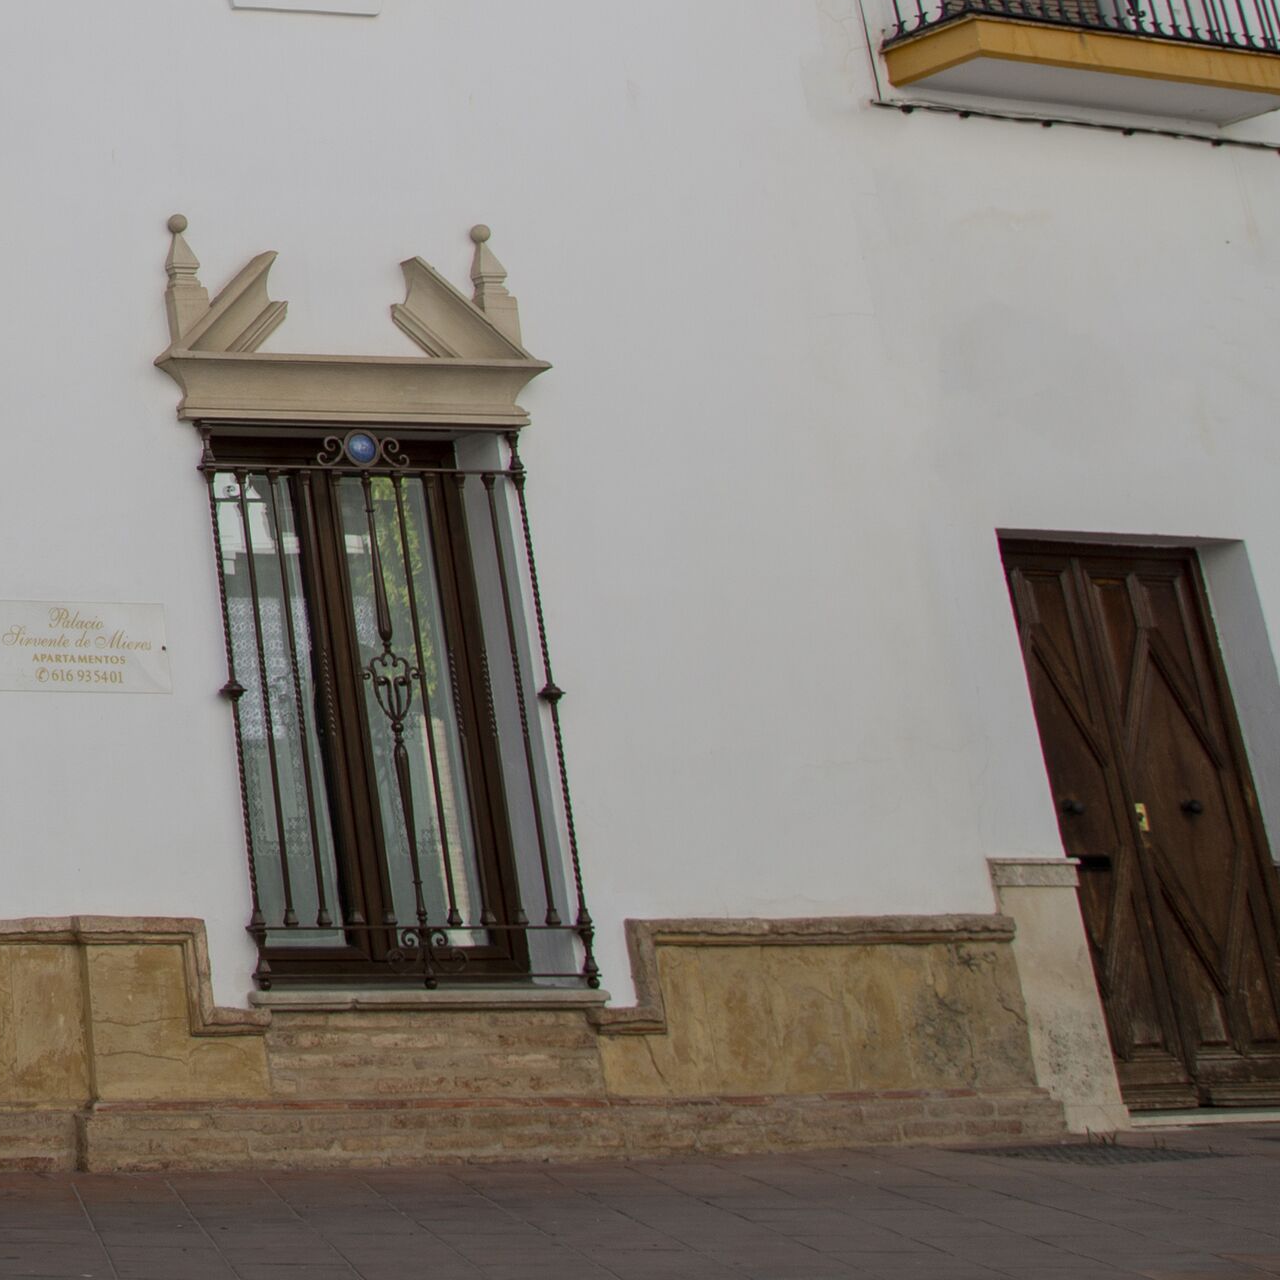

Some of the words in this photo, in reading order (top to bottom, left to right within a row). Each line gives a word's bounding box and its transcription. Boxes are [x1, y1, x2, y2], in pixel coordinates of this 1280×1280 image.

[48, 607, 105, 630] Palacio
[2, 624, 70, 648] Sirvente
[74, 631, 89, 648] de
[95, 629, 152, 651] Mieres
[32, 653, 126, 665] APARTAMENTOS
[51, 669, 74, 682] 616
